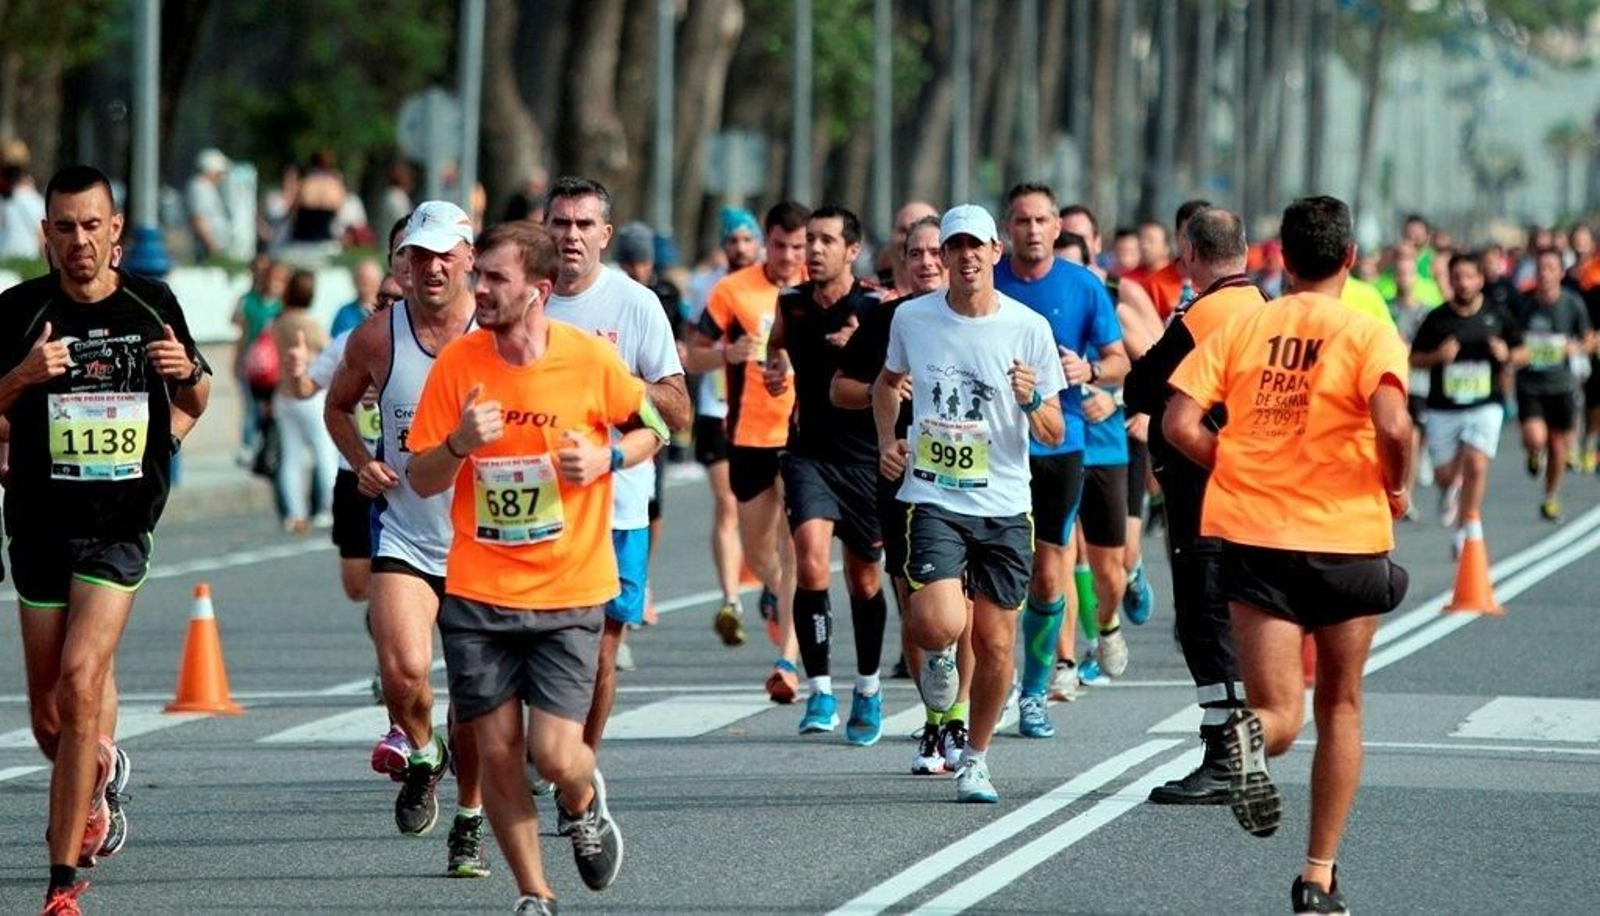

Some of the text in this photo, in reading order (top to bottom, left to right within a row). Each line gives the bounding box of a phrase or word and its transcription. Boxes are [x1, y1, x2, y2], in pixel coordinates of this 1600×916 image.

[1267, 335, 1324, 372] 10K
[1255, 392, 1271, 407] DE
[500, 409, 559, 429] PSOL
[62, 427, 136, 455] 1138
[930, 441, 974, 470] 998
[486, 487, 540, 518] 687
